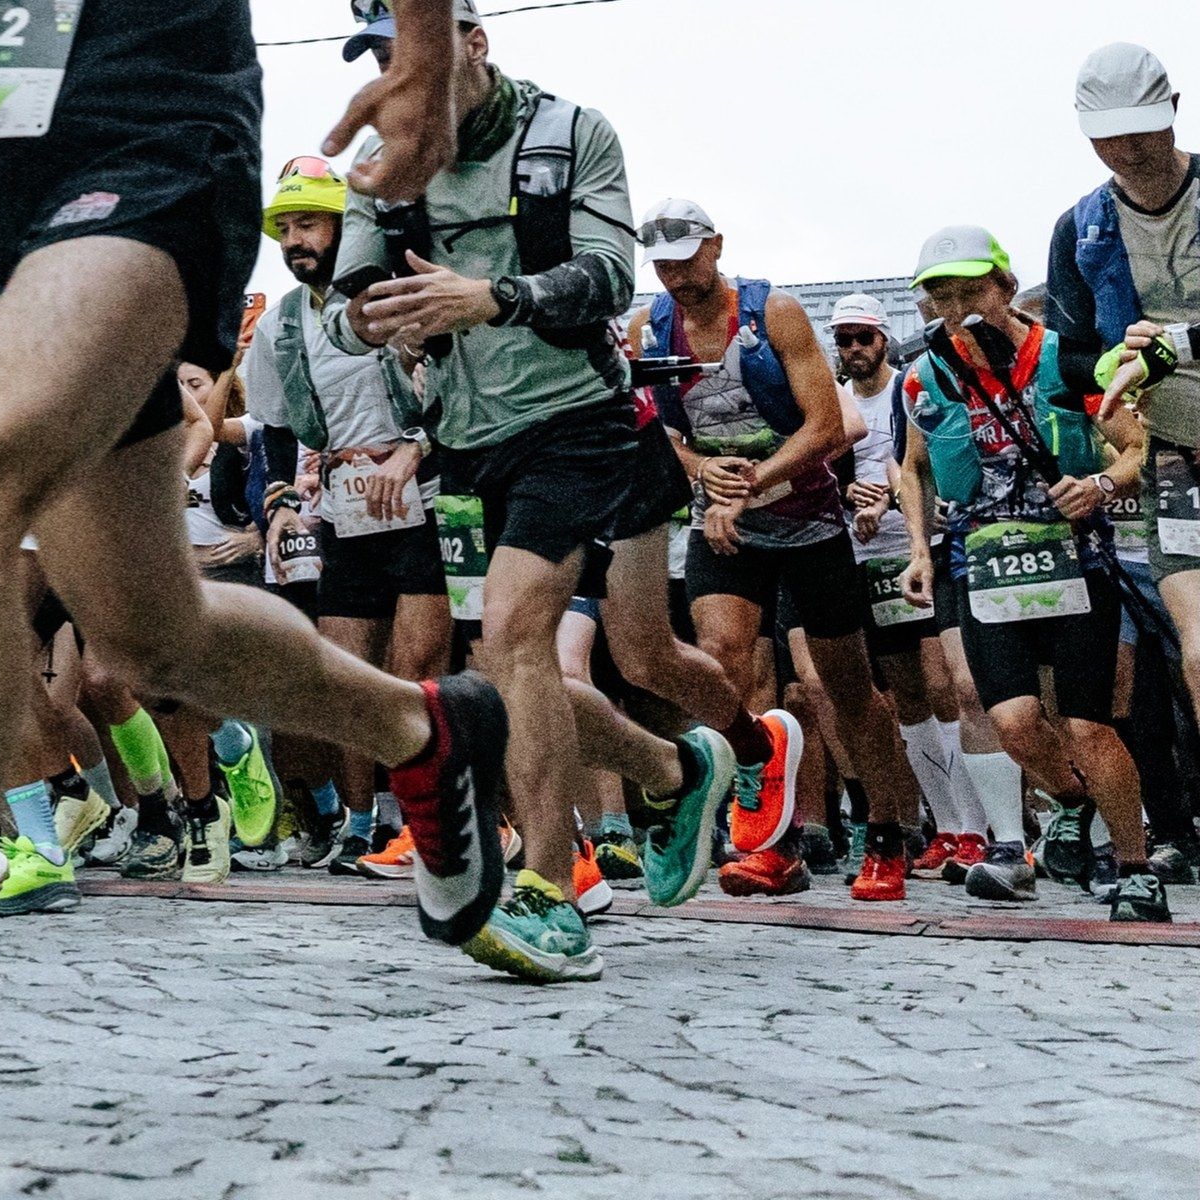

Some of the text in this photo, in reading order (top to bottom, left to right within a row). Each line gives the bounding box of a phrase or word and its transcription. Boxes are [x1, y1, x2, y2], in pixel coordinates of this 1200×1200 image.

[343, 476, 366, 495] 10
[1103, 498, 1142, 513] 20
[280, 536, 316, 554] 1003
[986, 550, 1056, 577] 1283
[874, 576, 902, 594] 133
